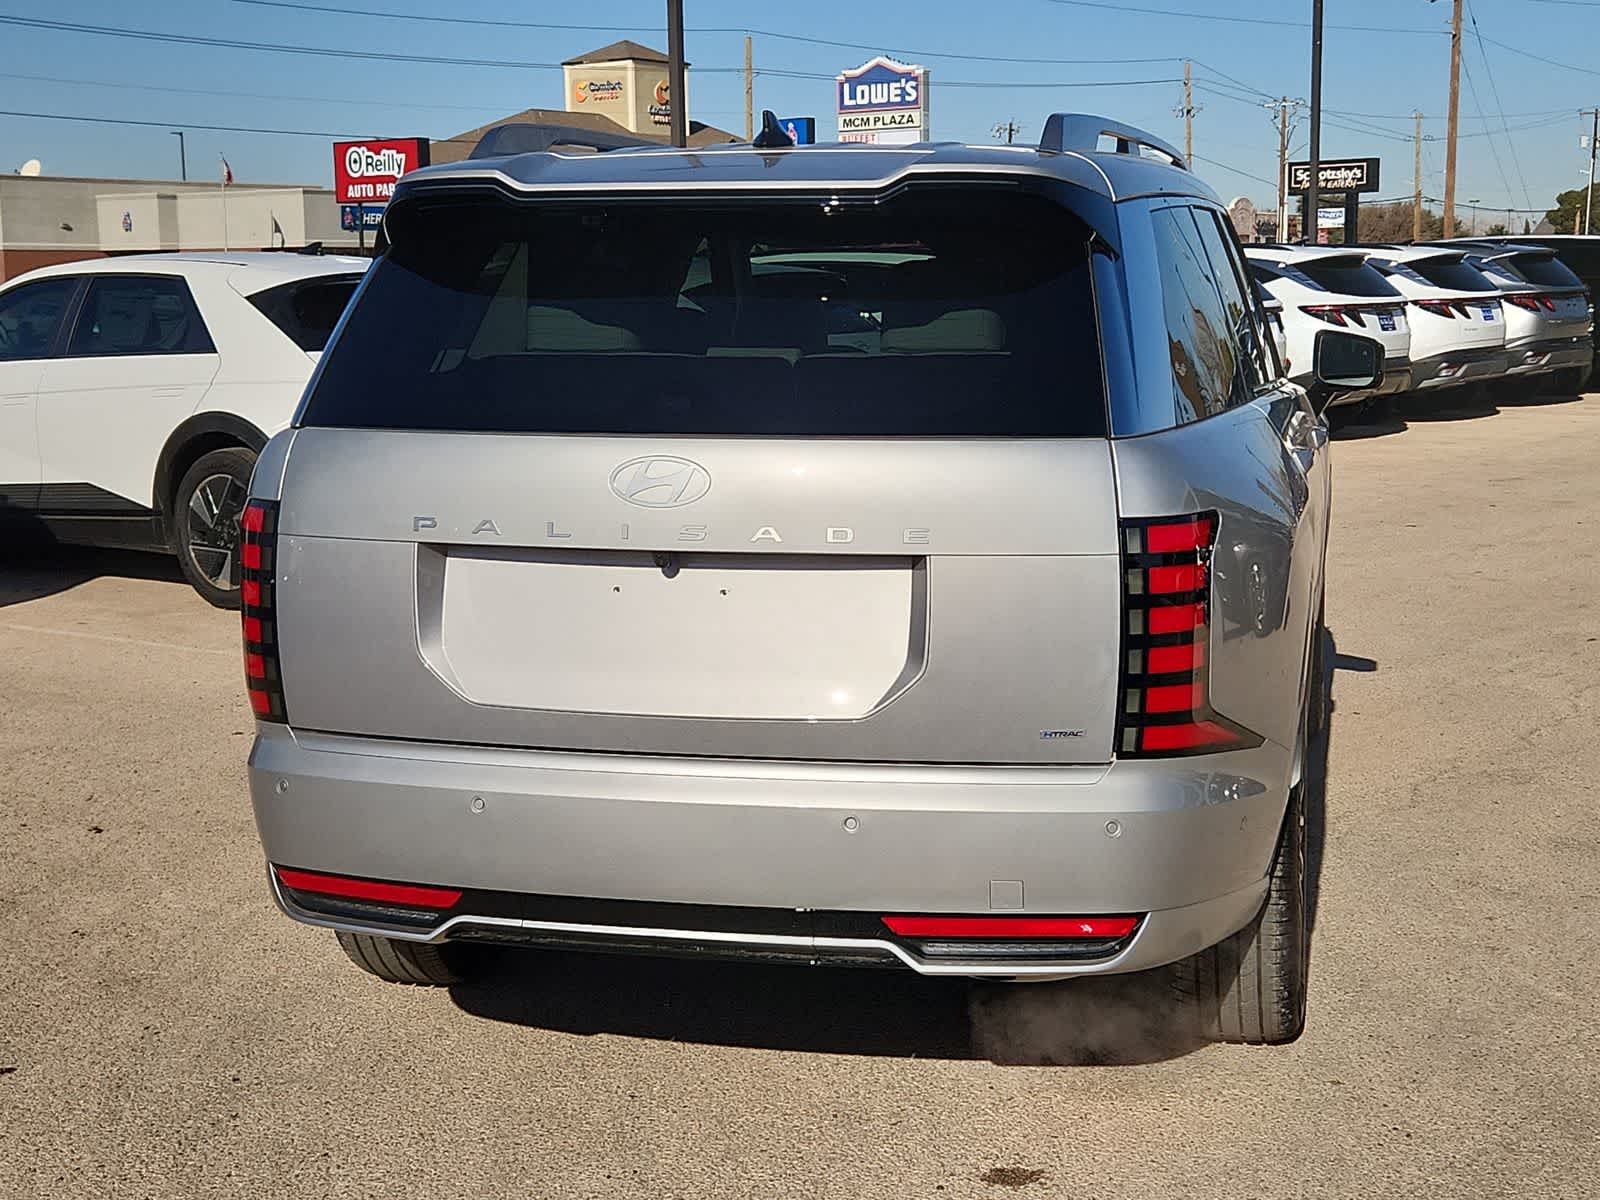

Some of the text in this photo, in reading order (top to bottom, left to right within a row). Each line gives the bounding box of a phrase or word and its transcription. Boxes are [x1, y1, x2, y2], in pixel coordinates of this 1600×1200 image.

[843, 79, 917, 105] LOWE'S
[842, 114, 914, 128] MCM PLAZA
[347, 148, 404, 176] O'Reilly
[1296, 167, 1362, 181] Scotzsky's
[347, 184, 395, 198] AUTO PAR
[413, 516, 930, 545] PALISADE
[1042, 730, 1084, 738] HTRAC
